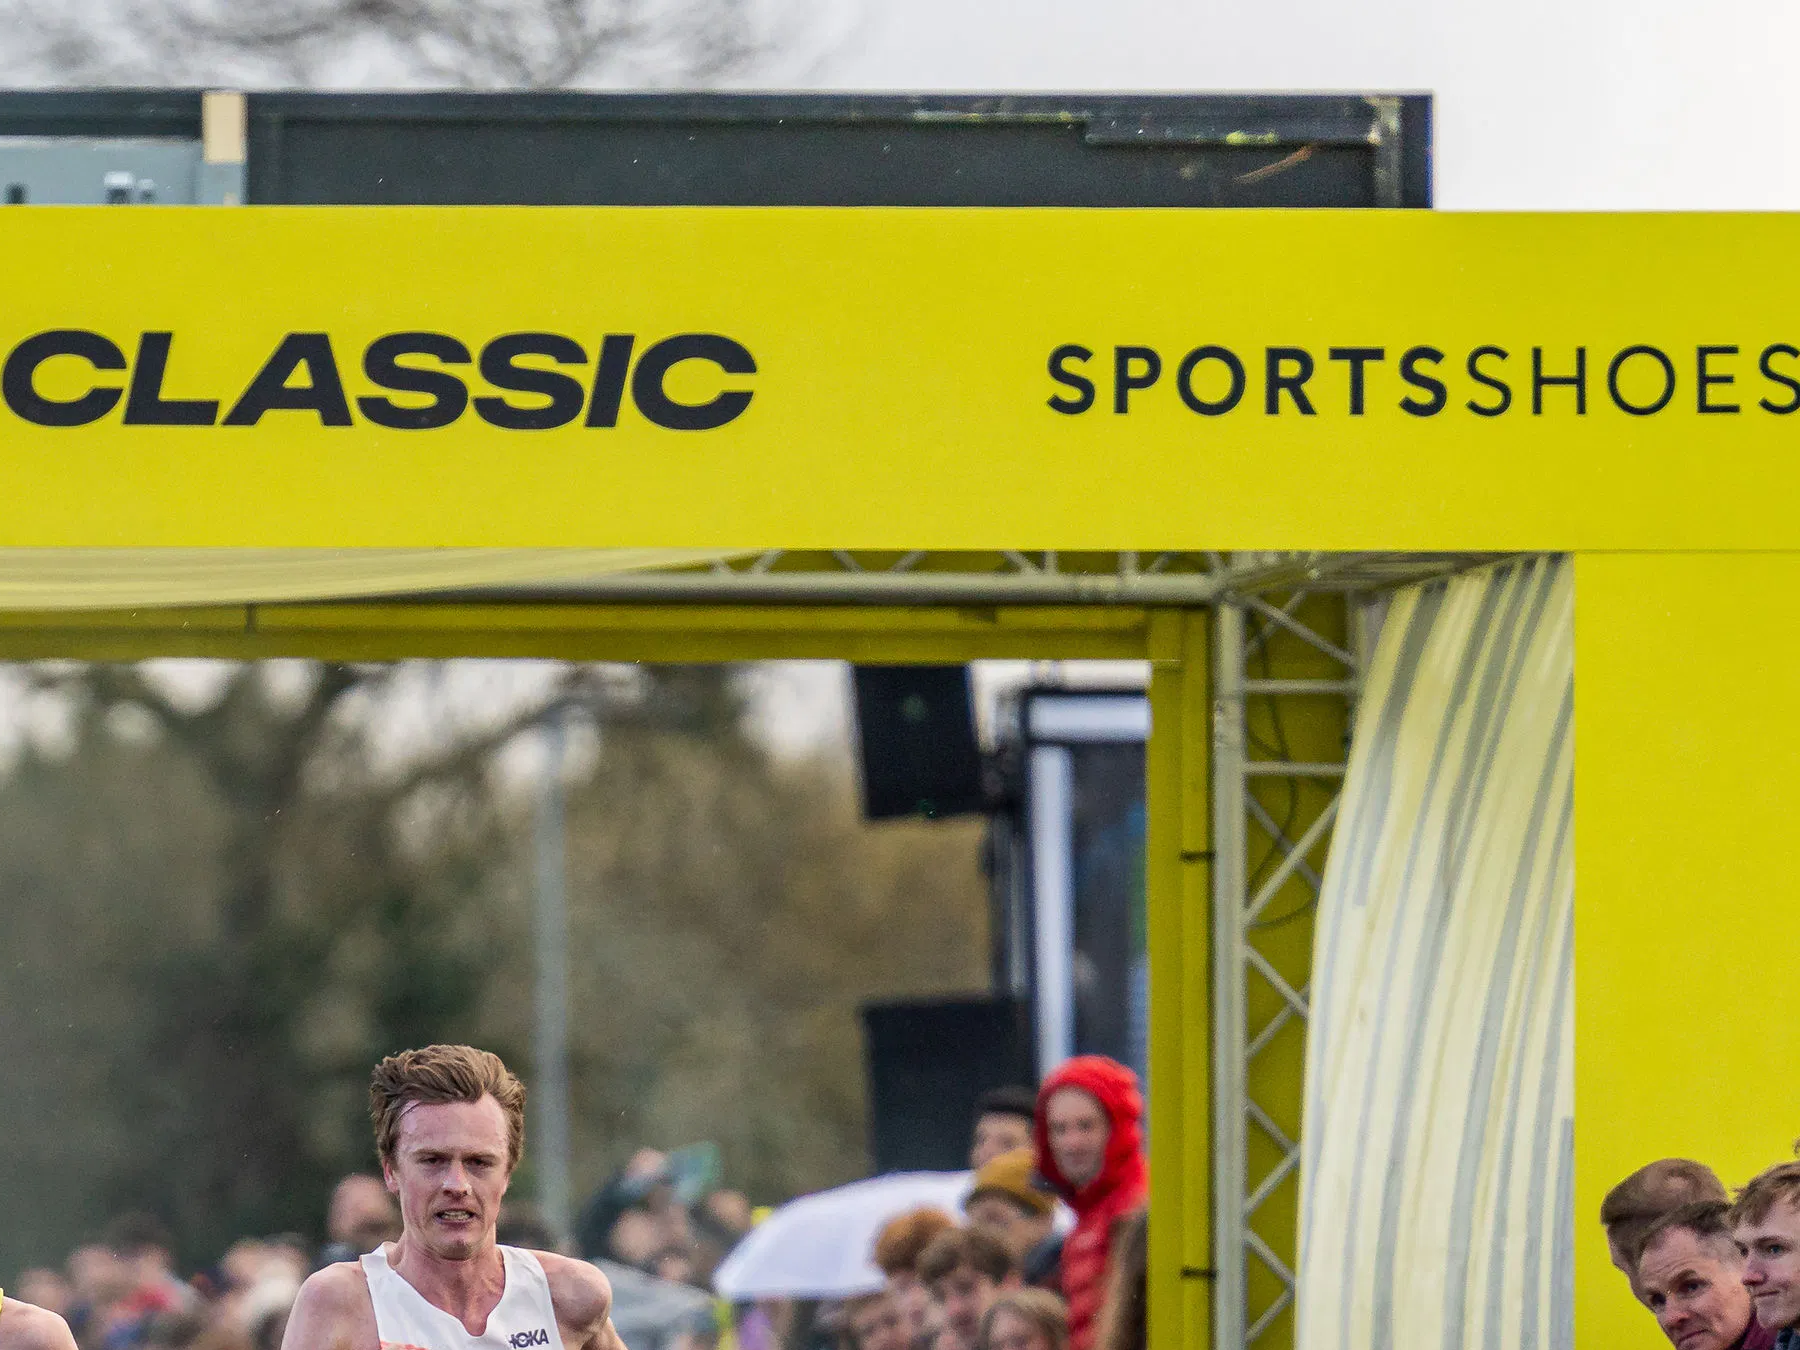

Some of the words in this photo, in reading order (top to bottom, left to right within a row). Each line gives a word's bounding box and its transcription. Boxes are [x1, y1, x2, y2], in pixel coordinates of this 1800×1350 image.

[2, 330, 757, 430] CLASSIC
[1047, 344, 1800, 417] SPORTSSHOES
[508, 1328, 550, 1350] HOKA
